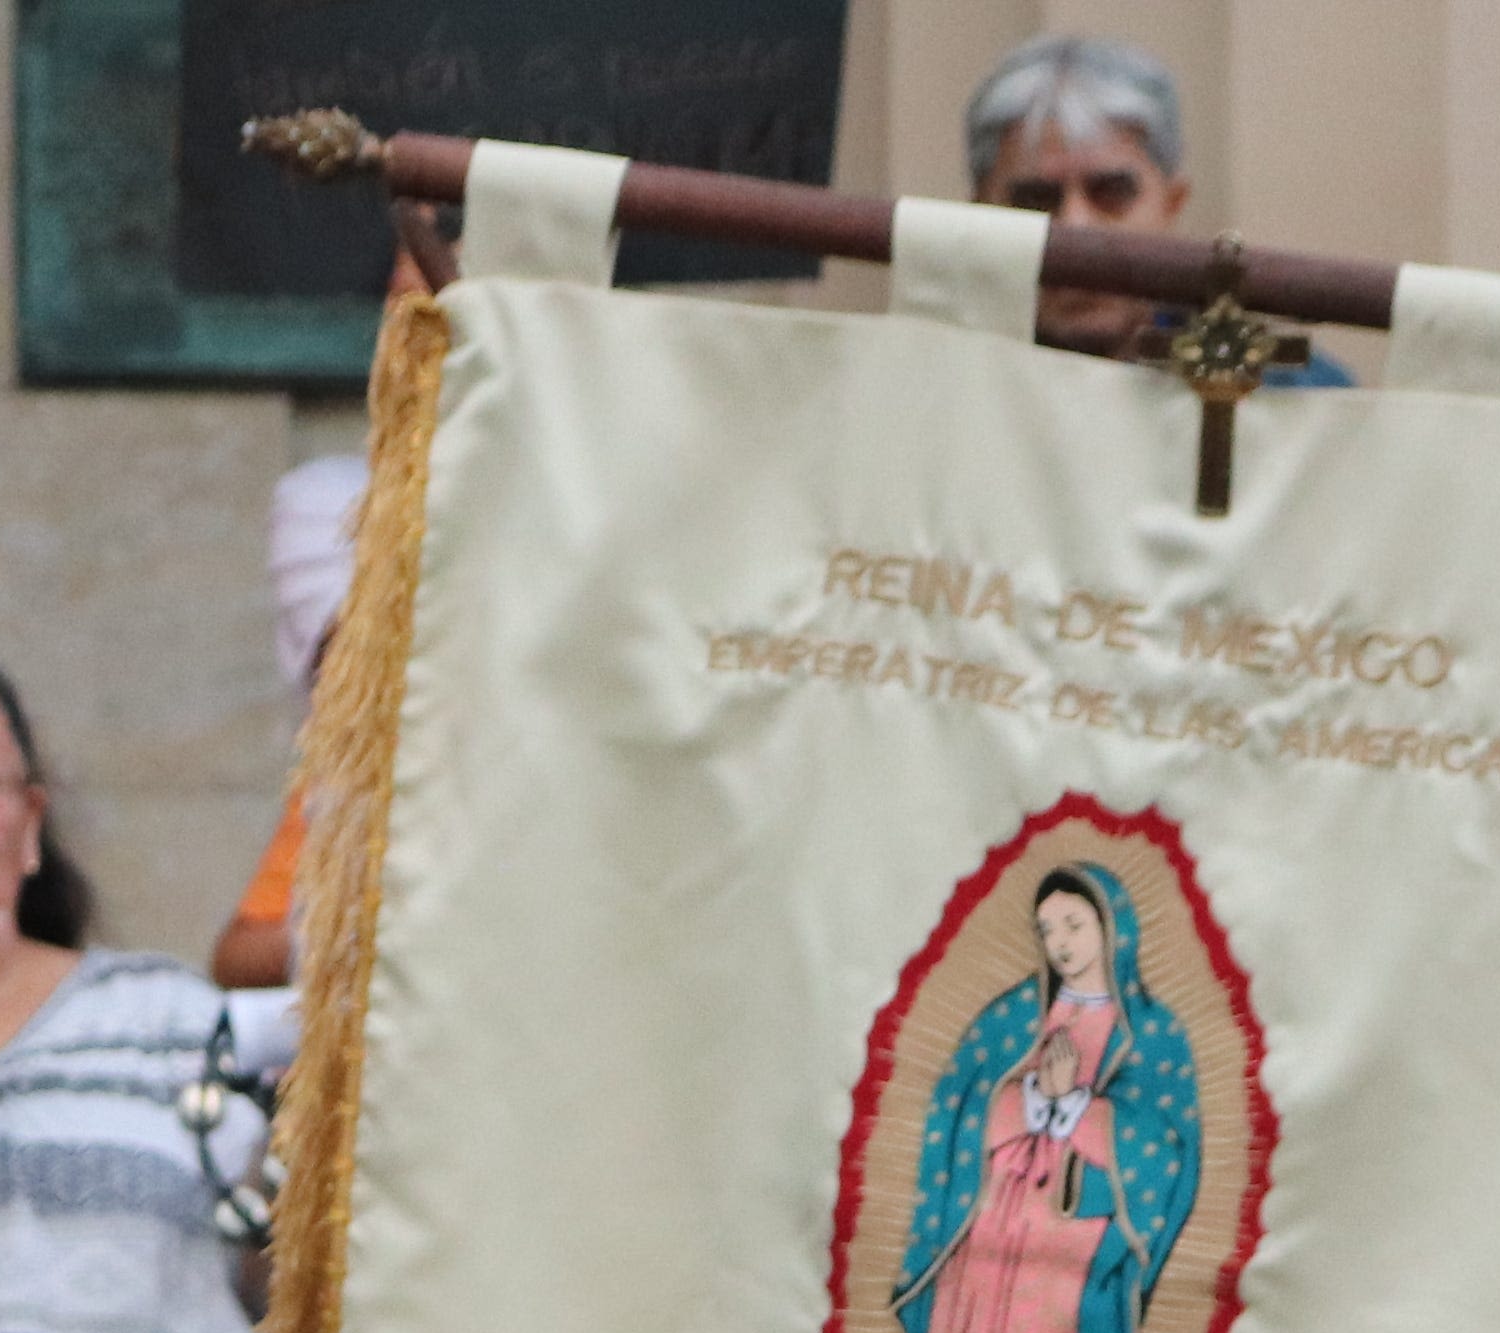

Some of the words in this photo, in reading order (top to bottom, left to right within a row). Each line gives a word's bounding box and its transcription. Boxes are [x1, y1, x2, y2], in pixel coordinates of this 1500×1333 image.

[823, 546, 1016, 627] REINA
[1056, 590, 1146, 651] DE
[1179, 602, 1456, 689] MEXICO
[706, 632, 1027, 711] EMPERATRIZ
[1049, 683, 1120, 728] DE
[1143, 696, 1245, 749] LAS
